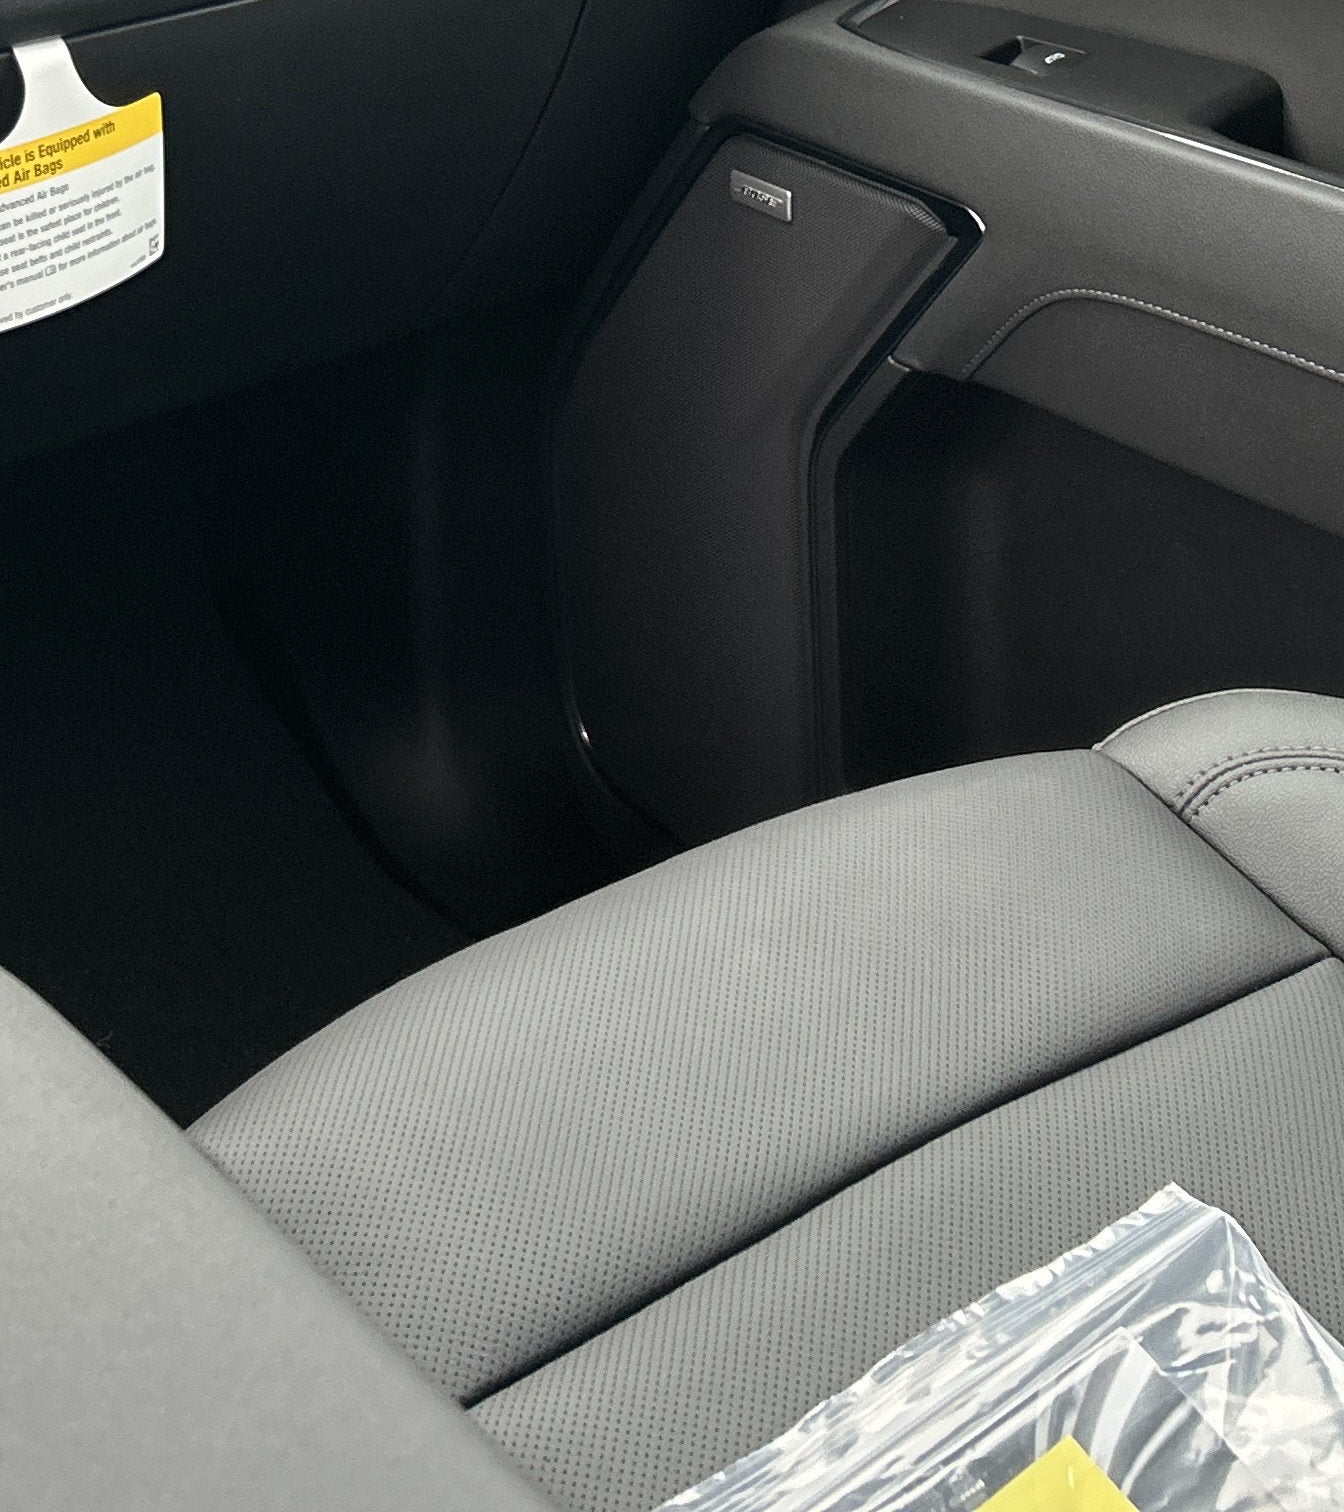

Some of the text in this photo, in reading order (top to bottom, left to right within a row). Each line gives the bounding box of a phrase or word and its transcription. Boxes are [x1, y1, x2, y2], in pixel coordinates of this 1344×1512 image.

[24, 149, 36, 163] is
[37, 128, 91, 158] Equipped
[92, 120, 116, 139] with
[13, 167, 31, 185] Air
[33, 158, 64, 177] Bags
